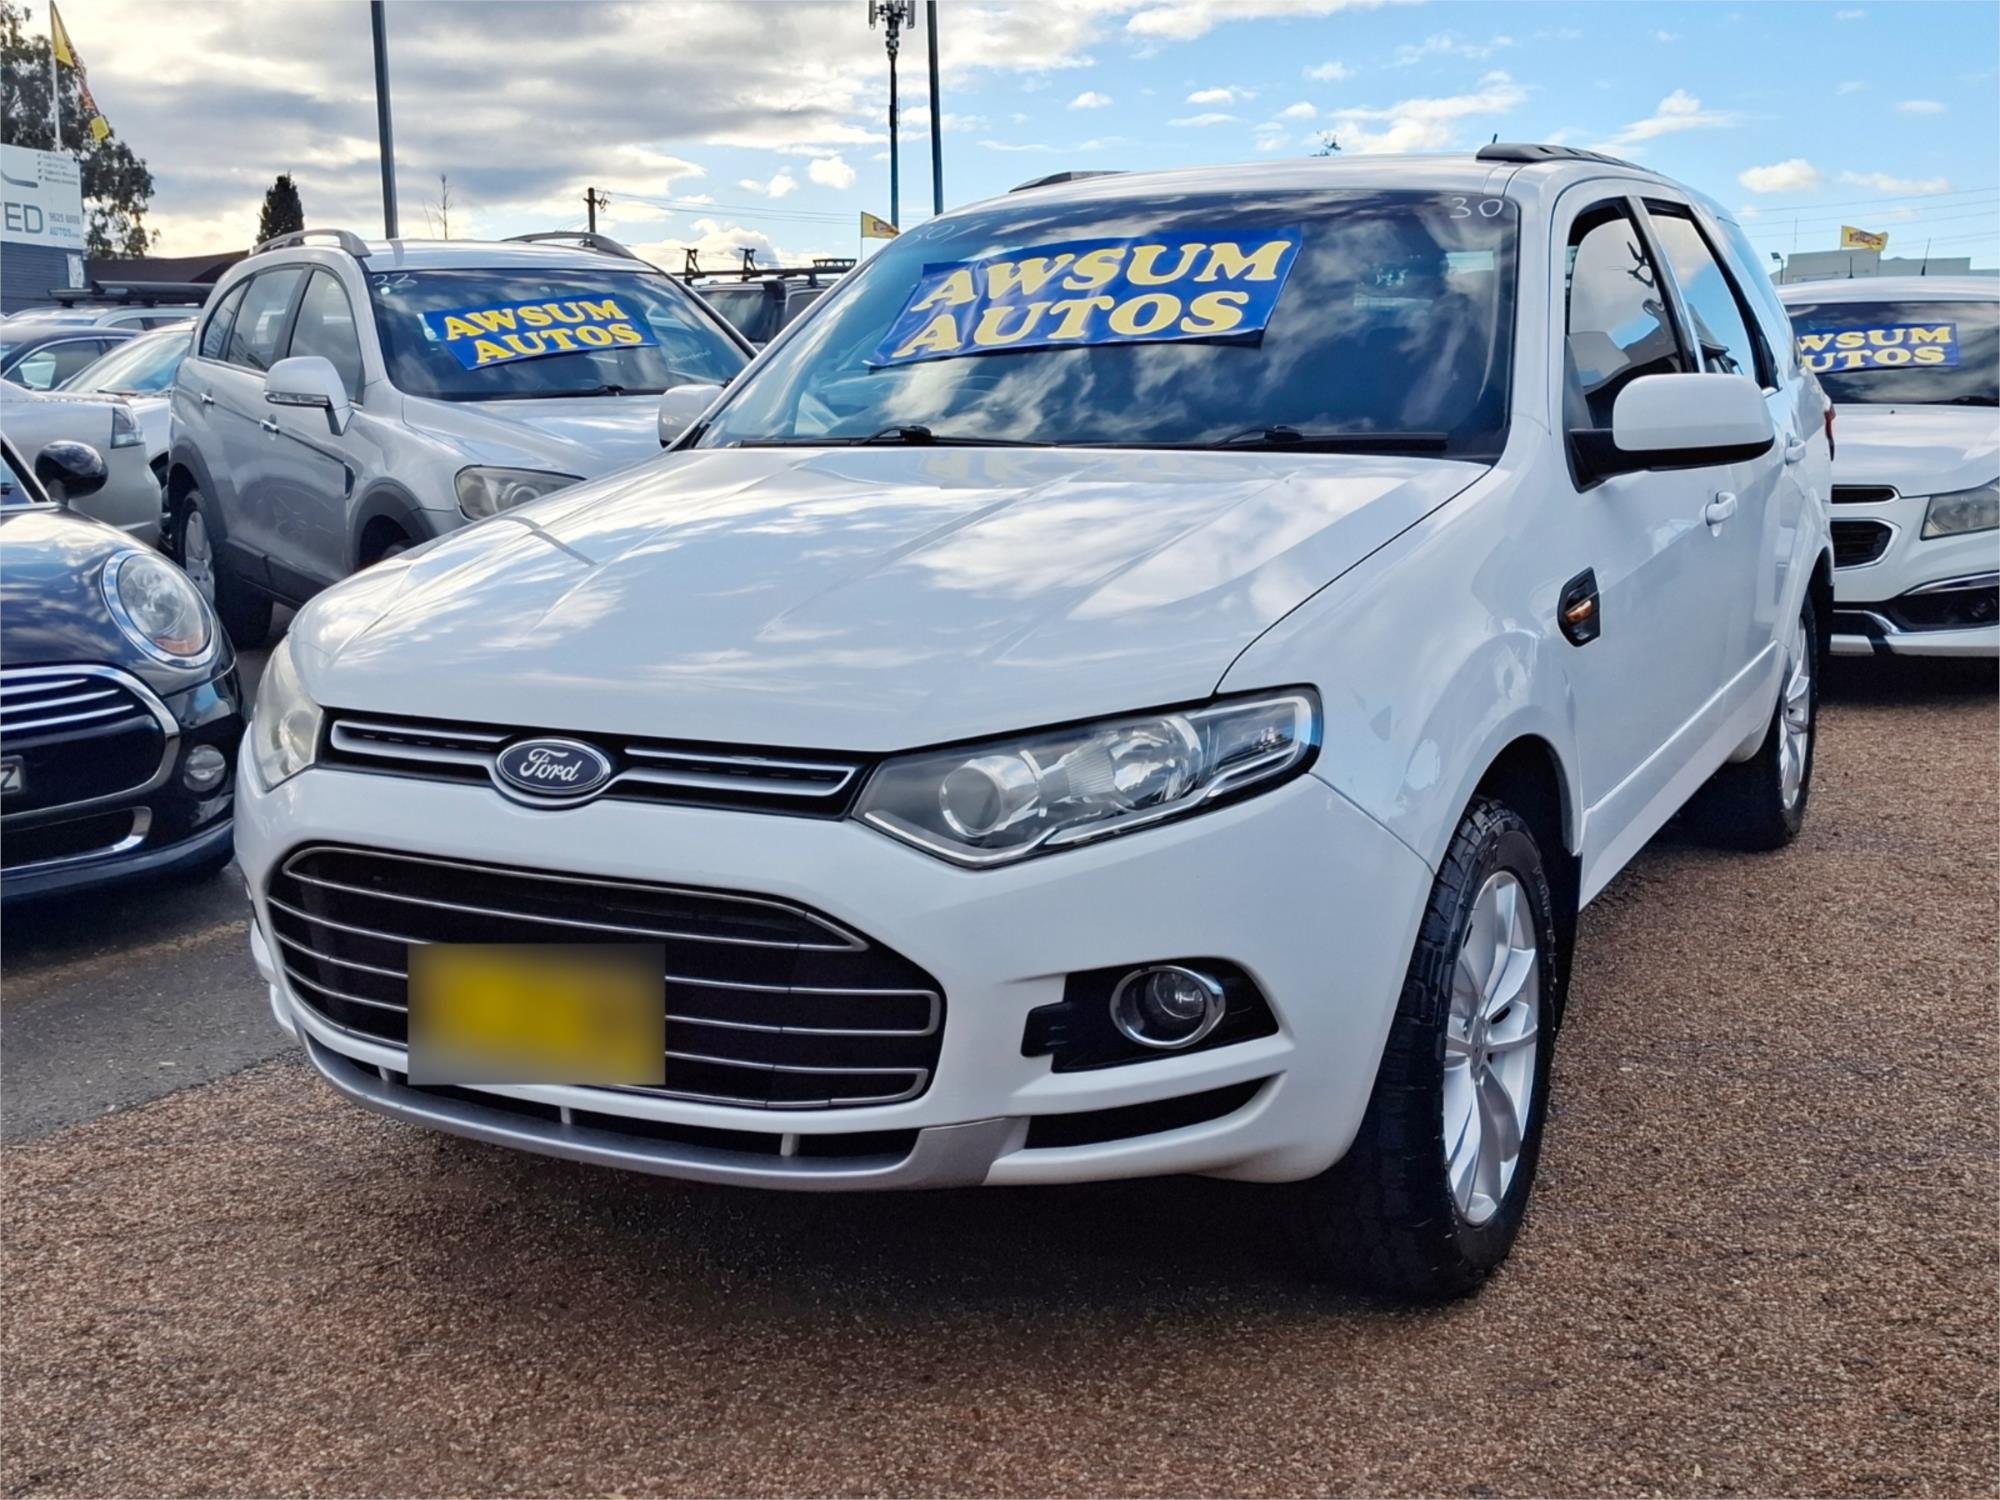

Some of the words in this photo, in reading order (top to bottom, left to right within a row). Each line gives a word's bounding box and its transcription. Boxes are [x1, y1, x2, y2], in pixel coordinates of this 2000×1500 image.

[0, 201, 43, 234] ED
[1449, 196, 1504, 218] 30
[911, 241, 1291, 312] AWSUM
[444, 299, 629, 341] AWSUM
[891, 291, 1250, 358] AUTOS
[473, 323, 642, 364] AUTOS
[1797, 326, 1952, 352] WSUM
[1800, 346, 1946, 373] UTOS
[519, 747, 583, 782] Ford
